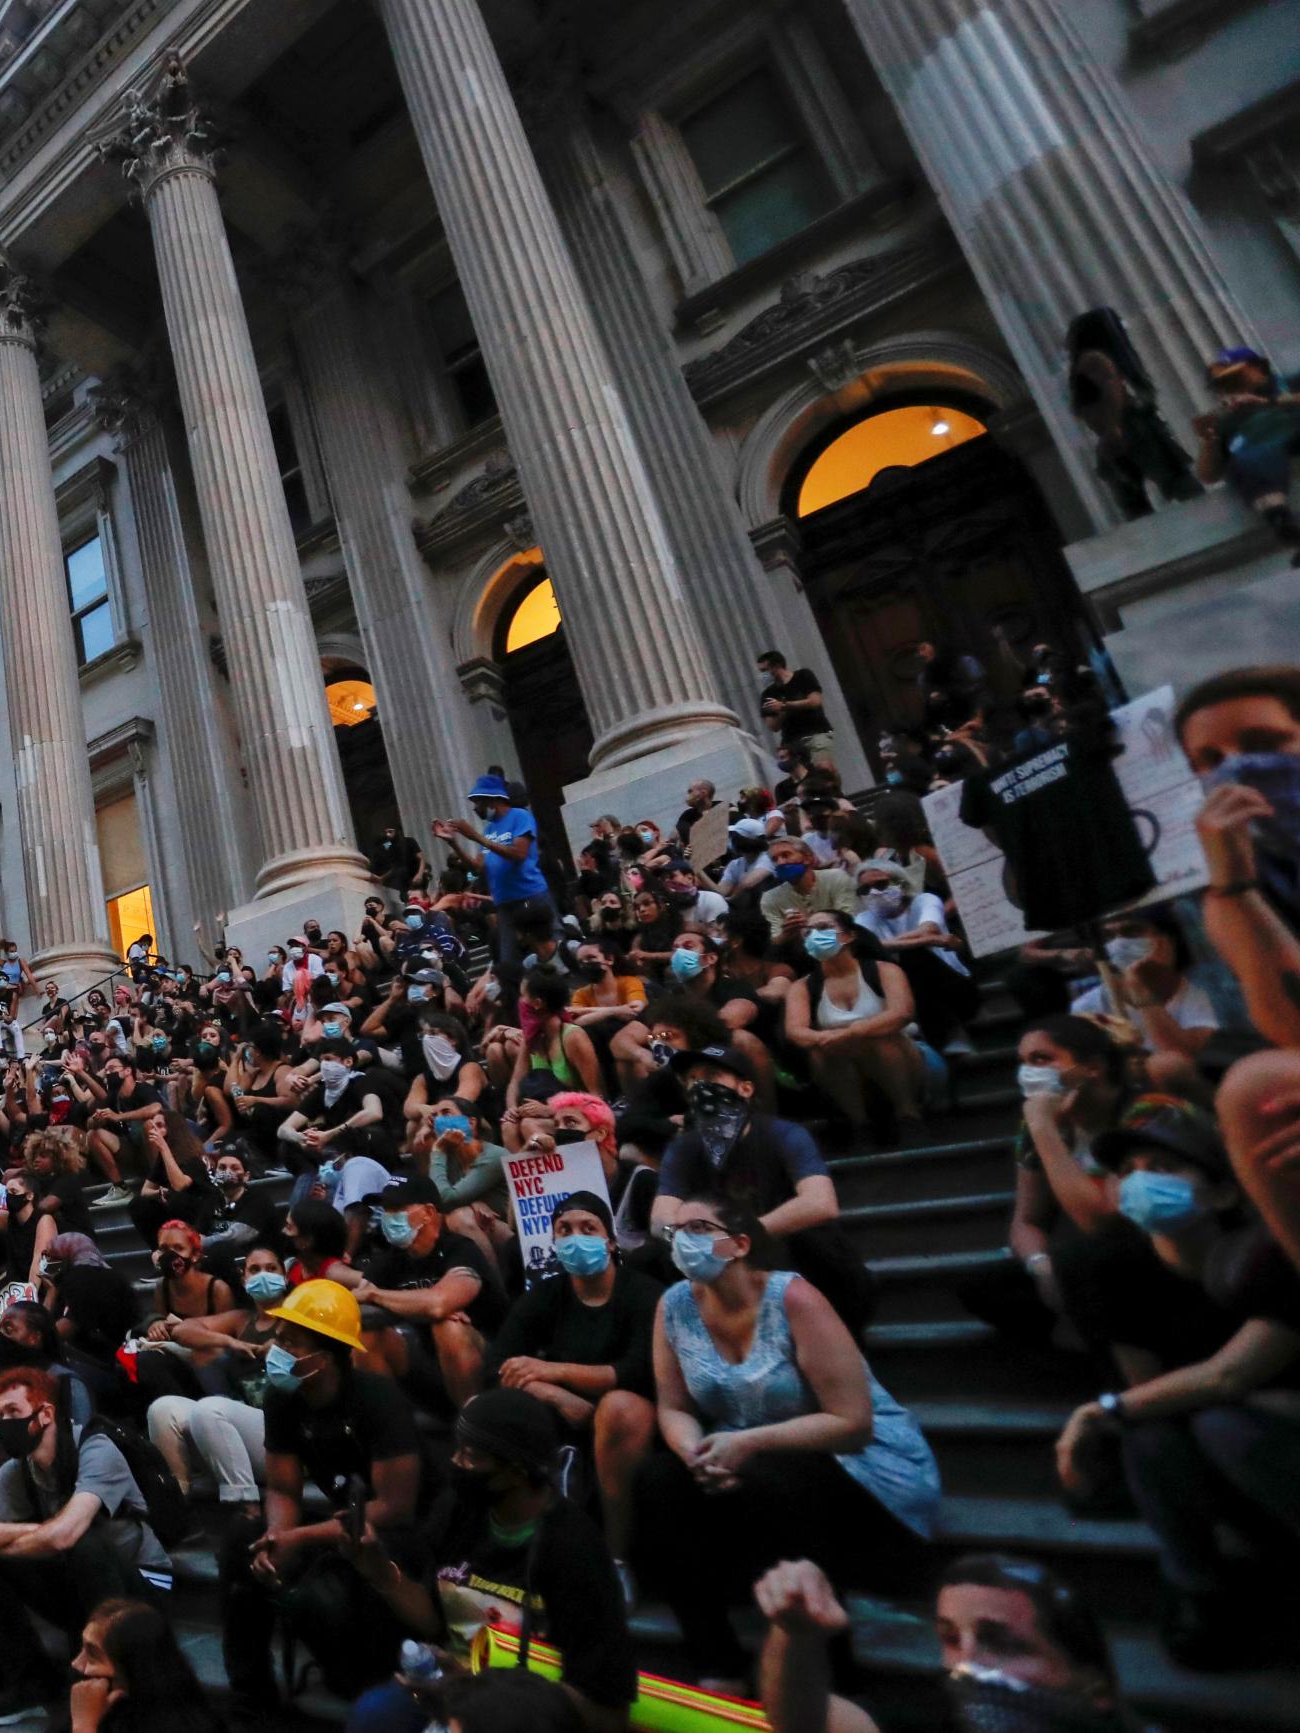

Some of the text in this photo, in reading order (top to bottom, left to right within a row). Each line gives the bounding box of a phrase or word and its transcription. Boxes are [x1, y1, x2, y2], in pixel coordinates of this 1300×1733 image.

[508, 1153, 564, 1179] DEFEND
[514, 1176, 544, 1198] NYC
[522, 1214, 555, 1236] NYP
